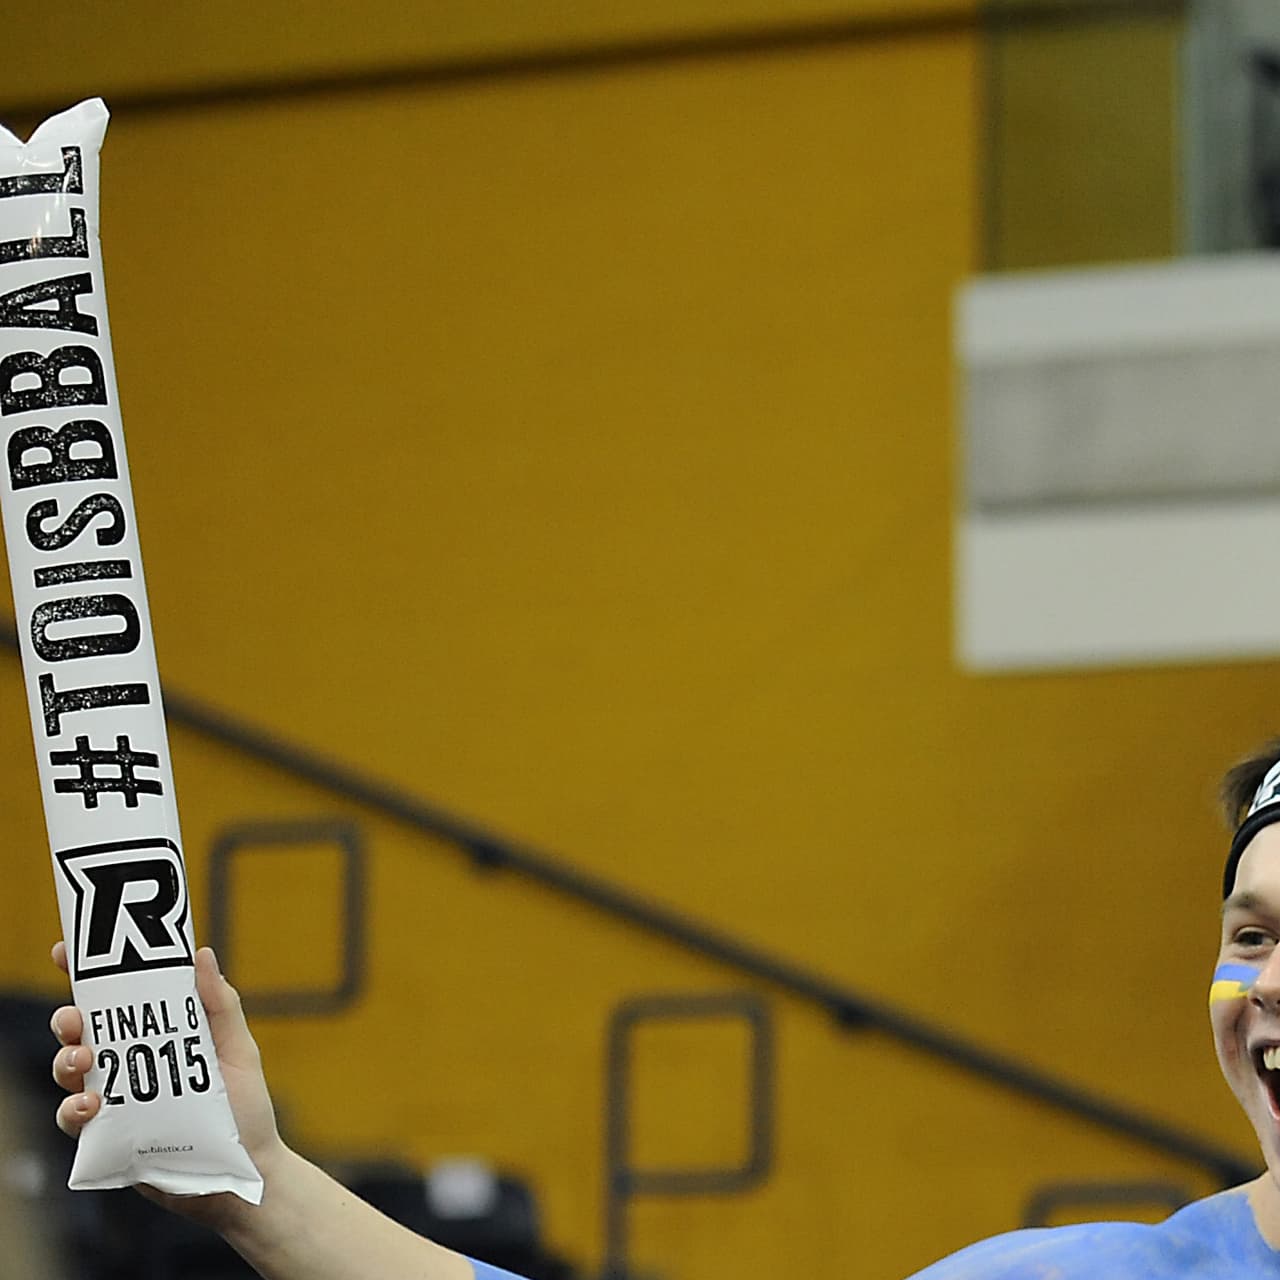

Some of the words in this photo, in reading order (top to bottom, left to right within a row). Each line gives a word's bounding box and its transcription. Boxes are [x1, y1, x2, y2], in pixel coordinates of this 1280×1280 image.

[0, 146, 165, 809] #TOISBBALL
[63, 846, 186, 972] R
[91, 1000, 178, 1044] FINAL
[185, 996, 199, 1030] 8
[98, 1036, 211, 1105] 2015
